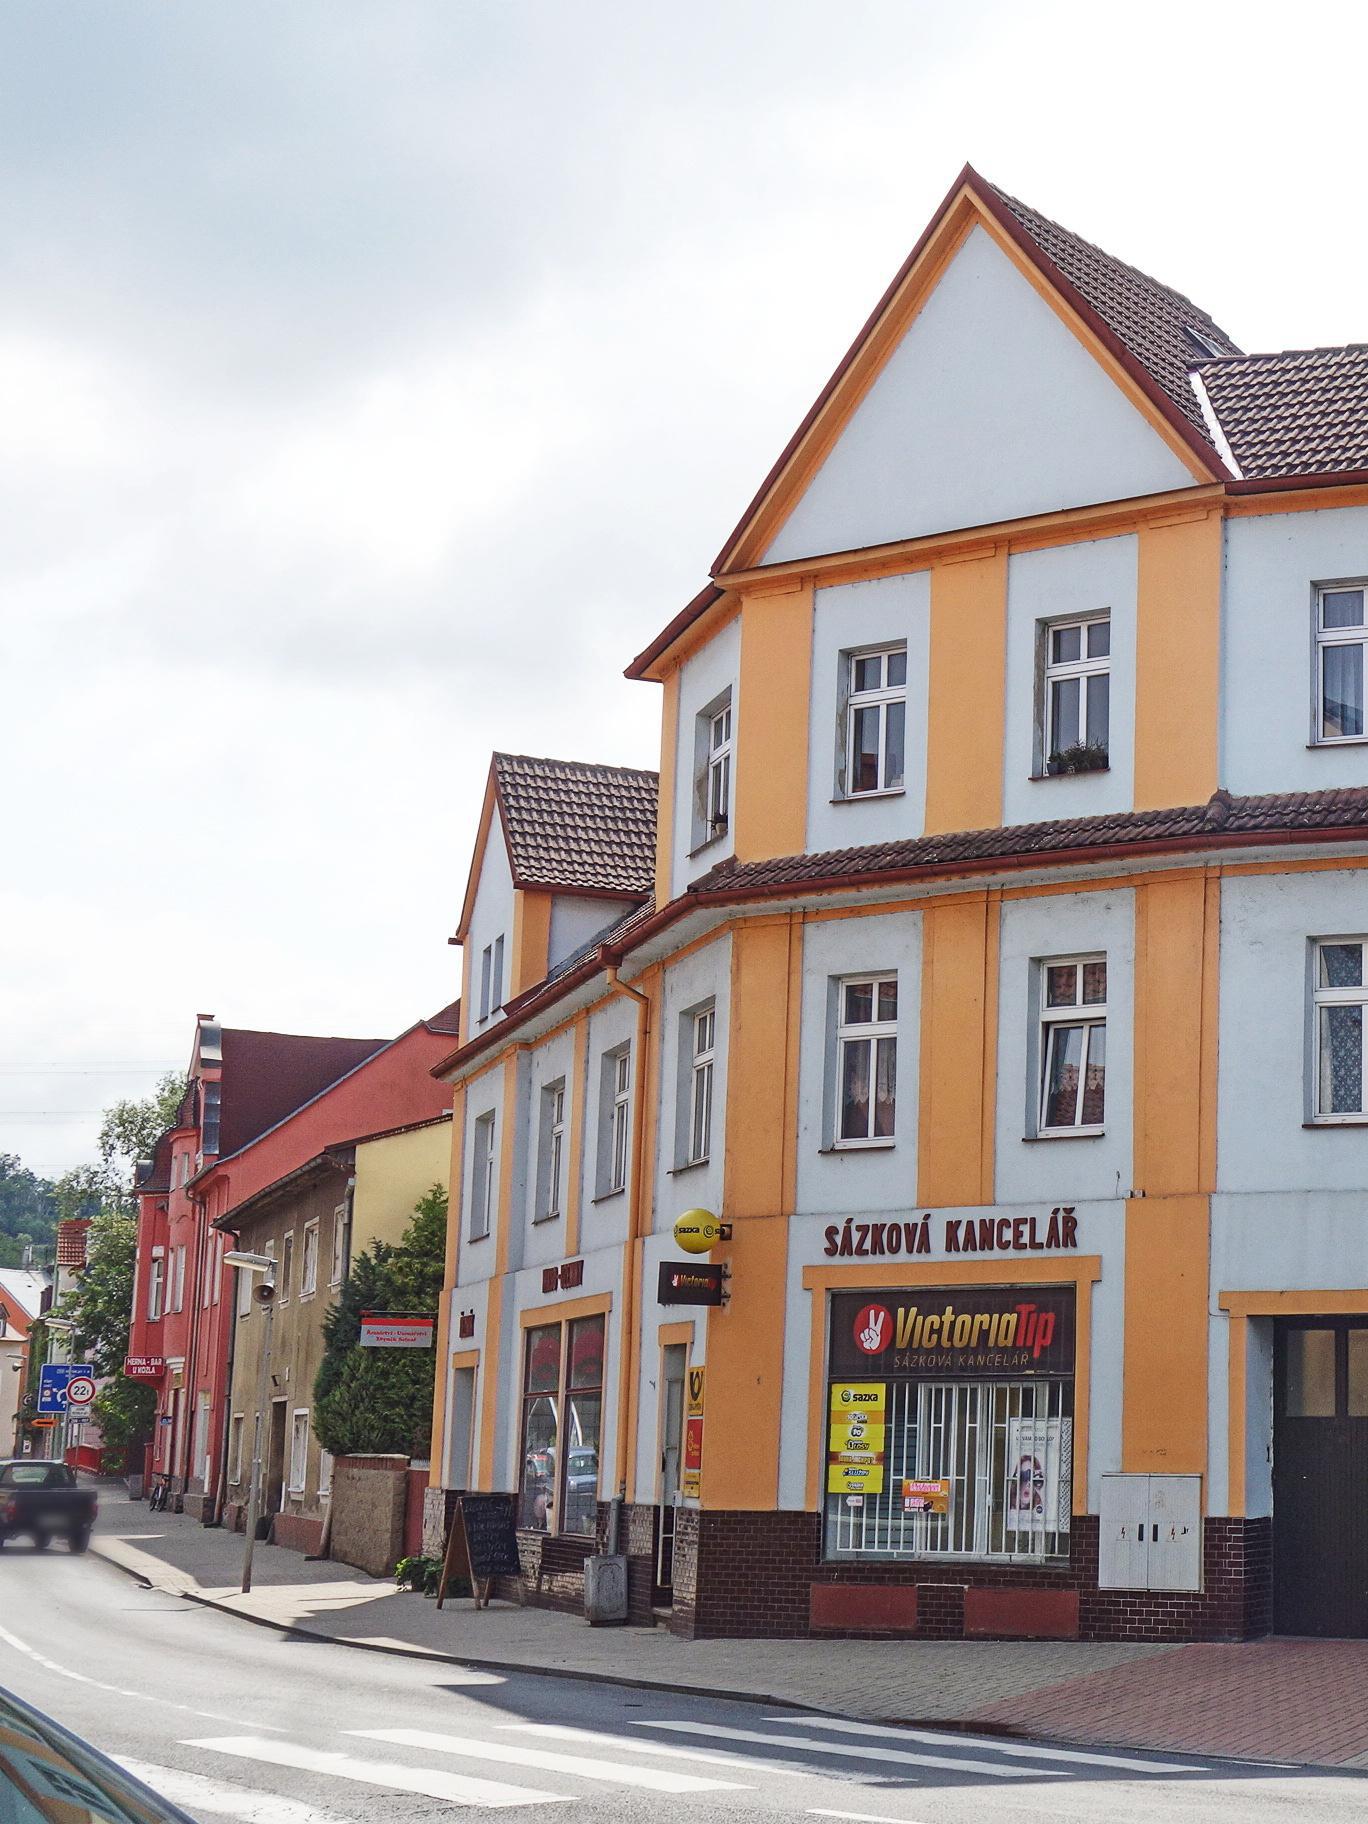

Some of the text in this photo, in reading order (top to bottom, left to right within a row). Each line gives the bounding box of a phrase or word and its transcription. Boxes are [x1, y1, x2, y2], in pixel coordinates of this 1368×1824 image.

[823, 1206, 1078, 1257] SÁZKOVÁ KANCELÁŘ
[127, 1358, 146, 1366] HERNA
[150, 1357, 162, 1366] BAR
[894, 1351, 1029, 1368] SÁZKOVÁ KANCELÁŘ
